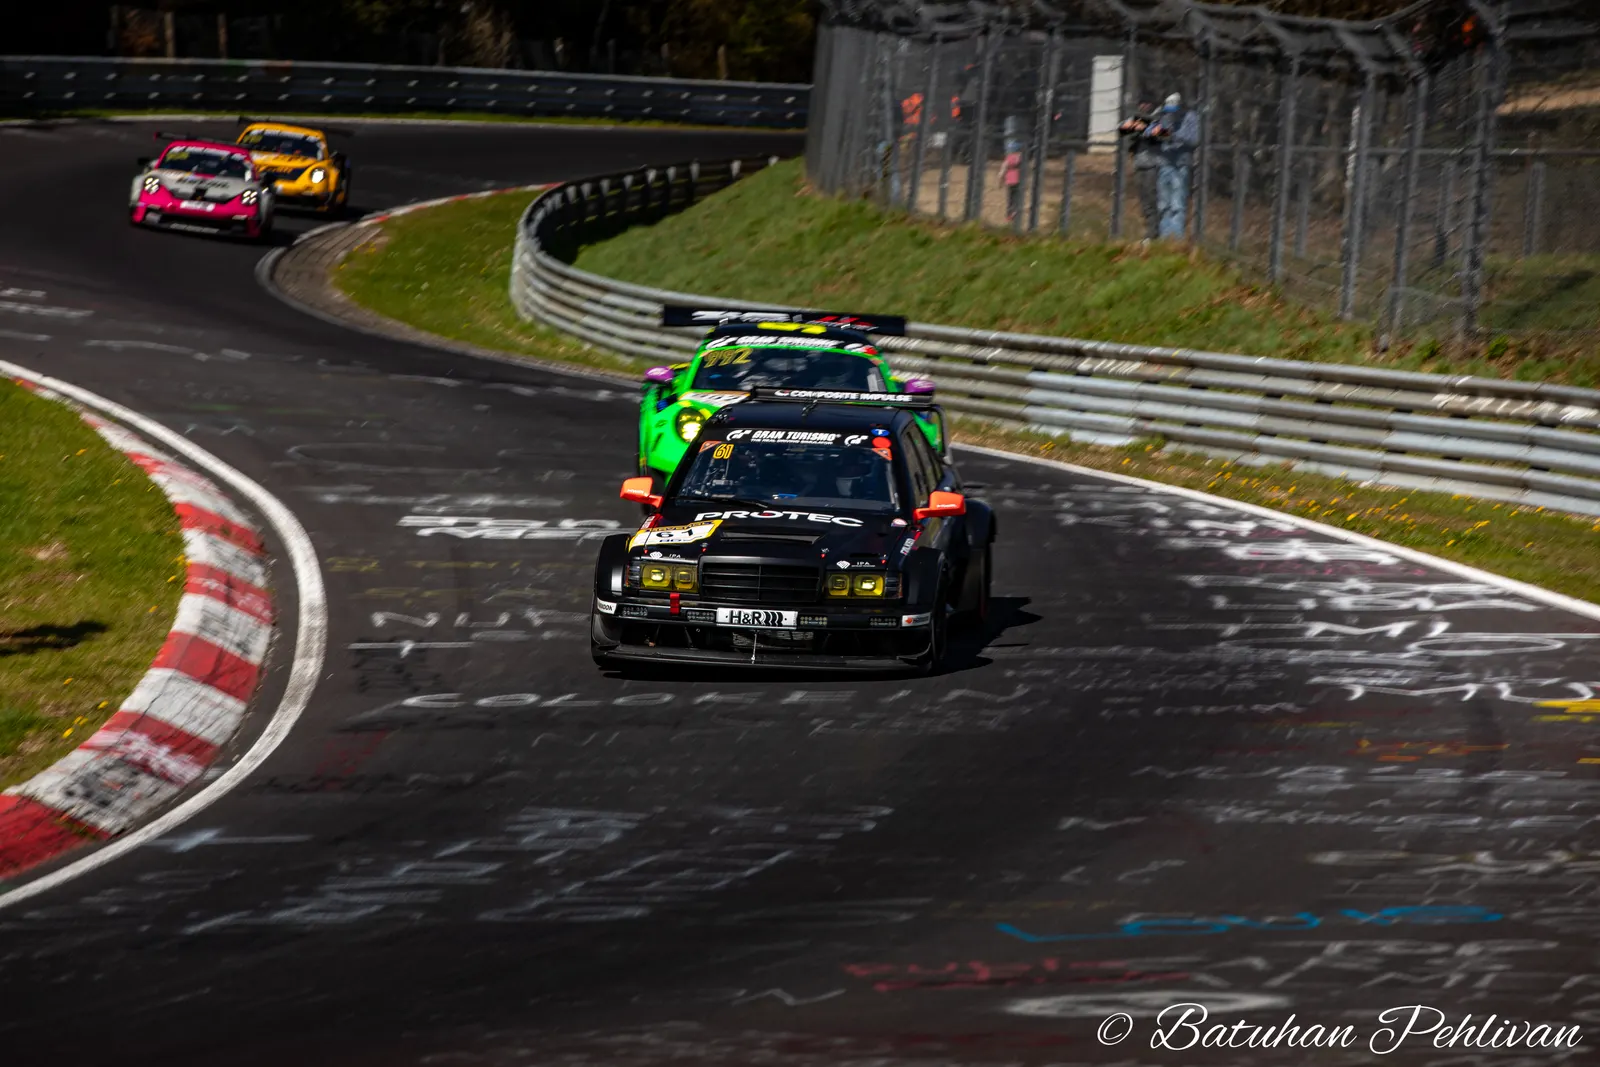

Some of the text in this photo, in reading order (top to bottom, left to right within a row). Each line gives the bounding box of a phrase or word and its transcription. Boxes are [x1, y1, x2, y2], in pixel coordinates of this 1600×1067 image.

[751, 430, 784, 440] GRAN
[787, 431, 836, 442] TURISMO
[713, 444, 734, 460] 61
[694, 510, 865, 527] PROTEC
[729, 609, 762, 626] H&R
